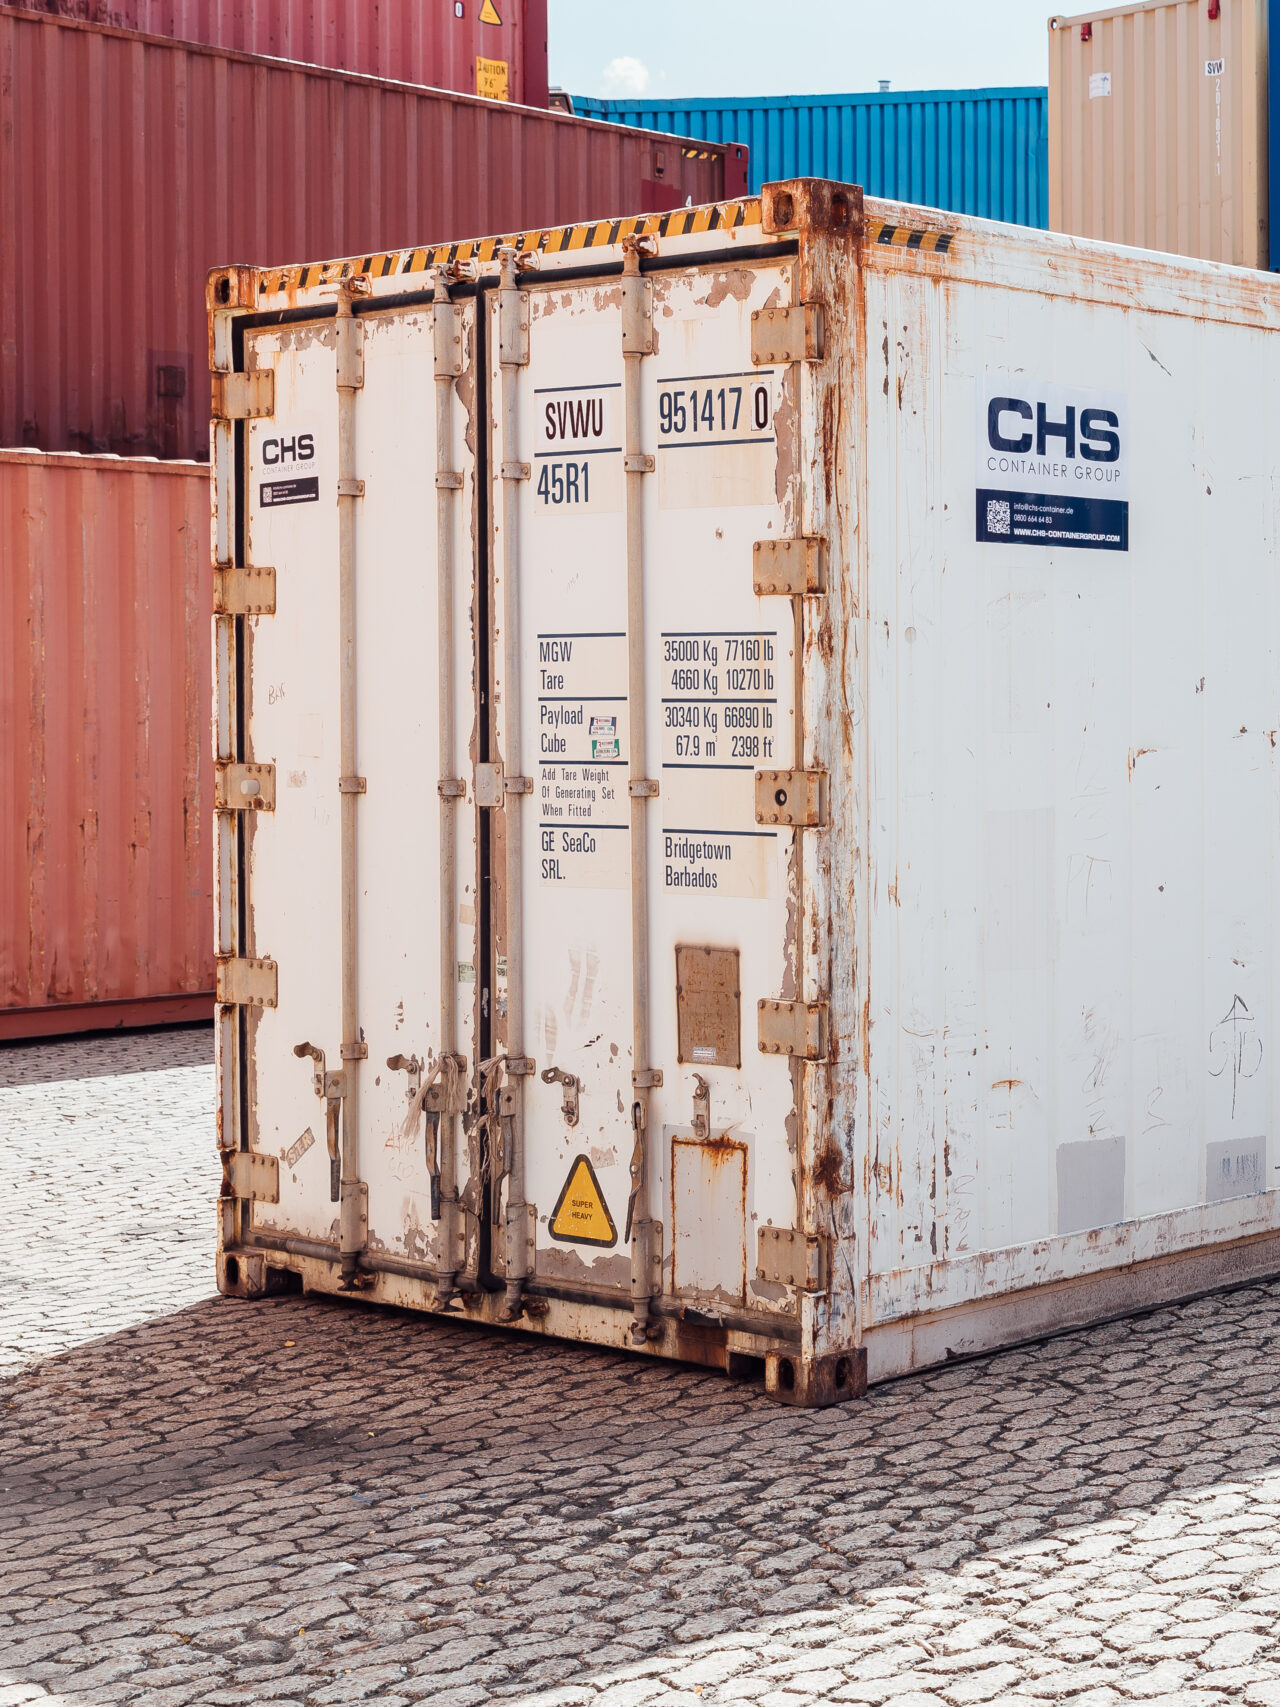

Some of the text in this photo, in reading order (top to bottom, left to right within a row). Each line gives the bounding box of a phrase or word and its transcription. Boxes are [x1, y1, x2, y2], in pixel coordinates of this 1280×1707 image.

[546, 386, 768, 439] SVWU 951417 0
[988, 397, 1120, 462] CHS
[262, 434, 315, 465] CHS
[987, 457, 1121, 482] CONTAINER GROUP
[537, 462, 589, 504] 45R1
[1014, 503, 1074, 514] info@chs-container.de
[1014, 514, 1027, 522] 0800
[1028, 515, 1037, 523] 664
[1014, 528, 1120, 542] WWW.CHS-CONTAINERGROUP.COM
[539, 641, 572, 663] MGW
[664, 639, 774, 666] 35000 Kg 77160 lb
[540, 670, 564, 690] Tare
[671, 668, 774, 695] 4660 Kg 10270 lb
[540, 705, 583, 729] Payload
[665, 707, 773, 733] 30340 Kg 66890 lb
[540, 733, 566, 753] Cube
[676, 735, 700, 756] 67.9
[731, 735, 759, 757] 2398
[542, 768, 609, 784] Add Tare Weight
[542, 786, 615, 801] Of Generating Set
[542, 804, 592, 817] When Fitted
[541, 831, 596, 853] GE SeaCo
[665, 836, 731, 864] Bridgetown
[541, 859, 566, 880] SRL.
[665, 865, 718, 888] Barbados
[572, 1200, 593, 1209] SUPER
[572, 1212, 593, 1221] HEAVY
